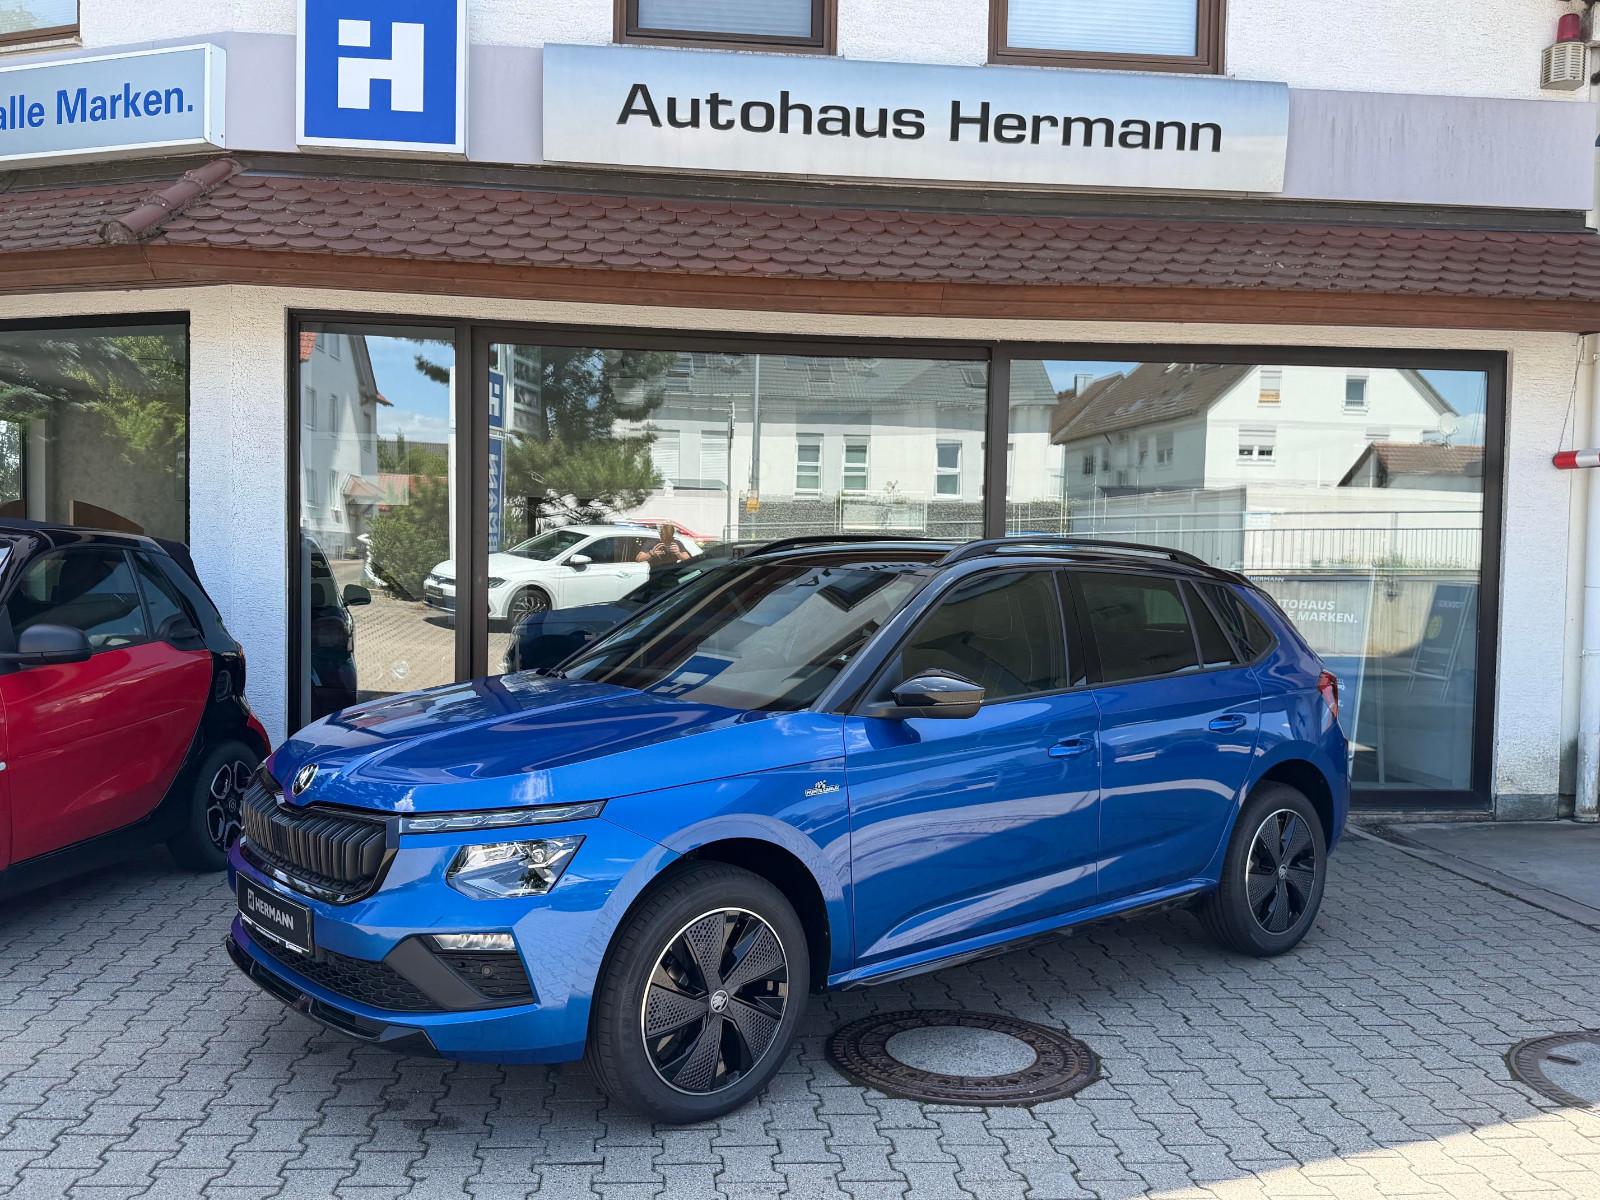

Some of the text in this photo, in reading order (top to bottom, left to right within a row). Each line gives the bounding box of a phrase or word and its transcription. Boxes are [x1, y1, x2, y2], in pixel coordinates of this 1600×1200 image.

[57, 83, 193, 124] Marken.
[616, 83, 1222, 152] Autohaus Hermann
[1297, 611, 1358, 624] MARKEN.
[255, 897, 294, 930] HERMANN
